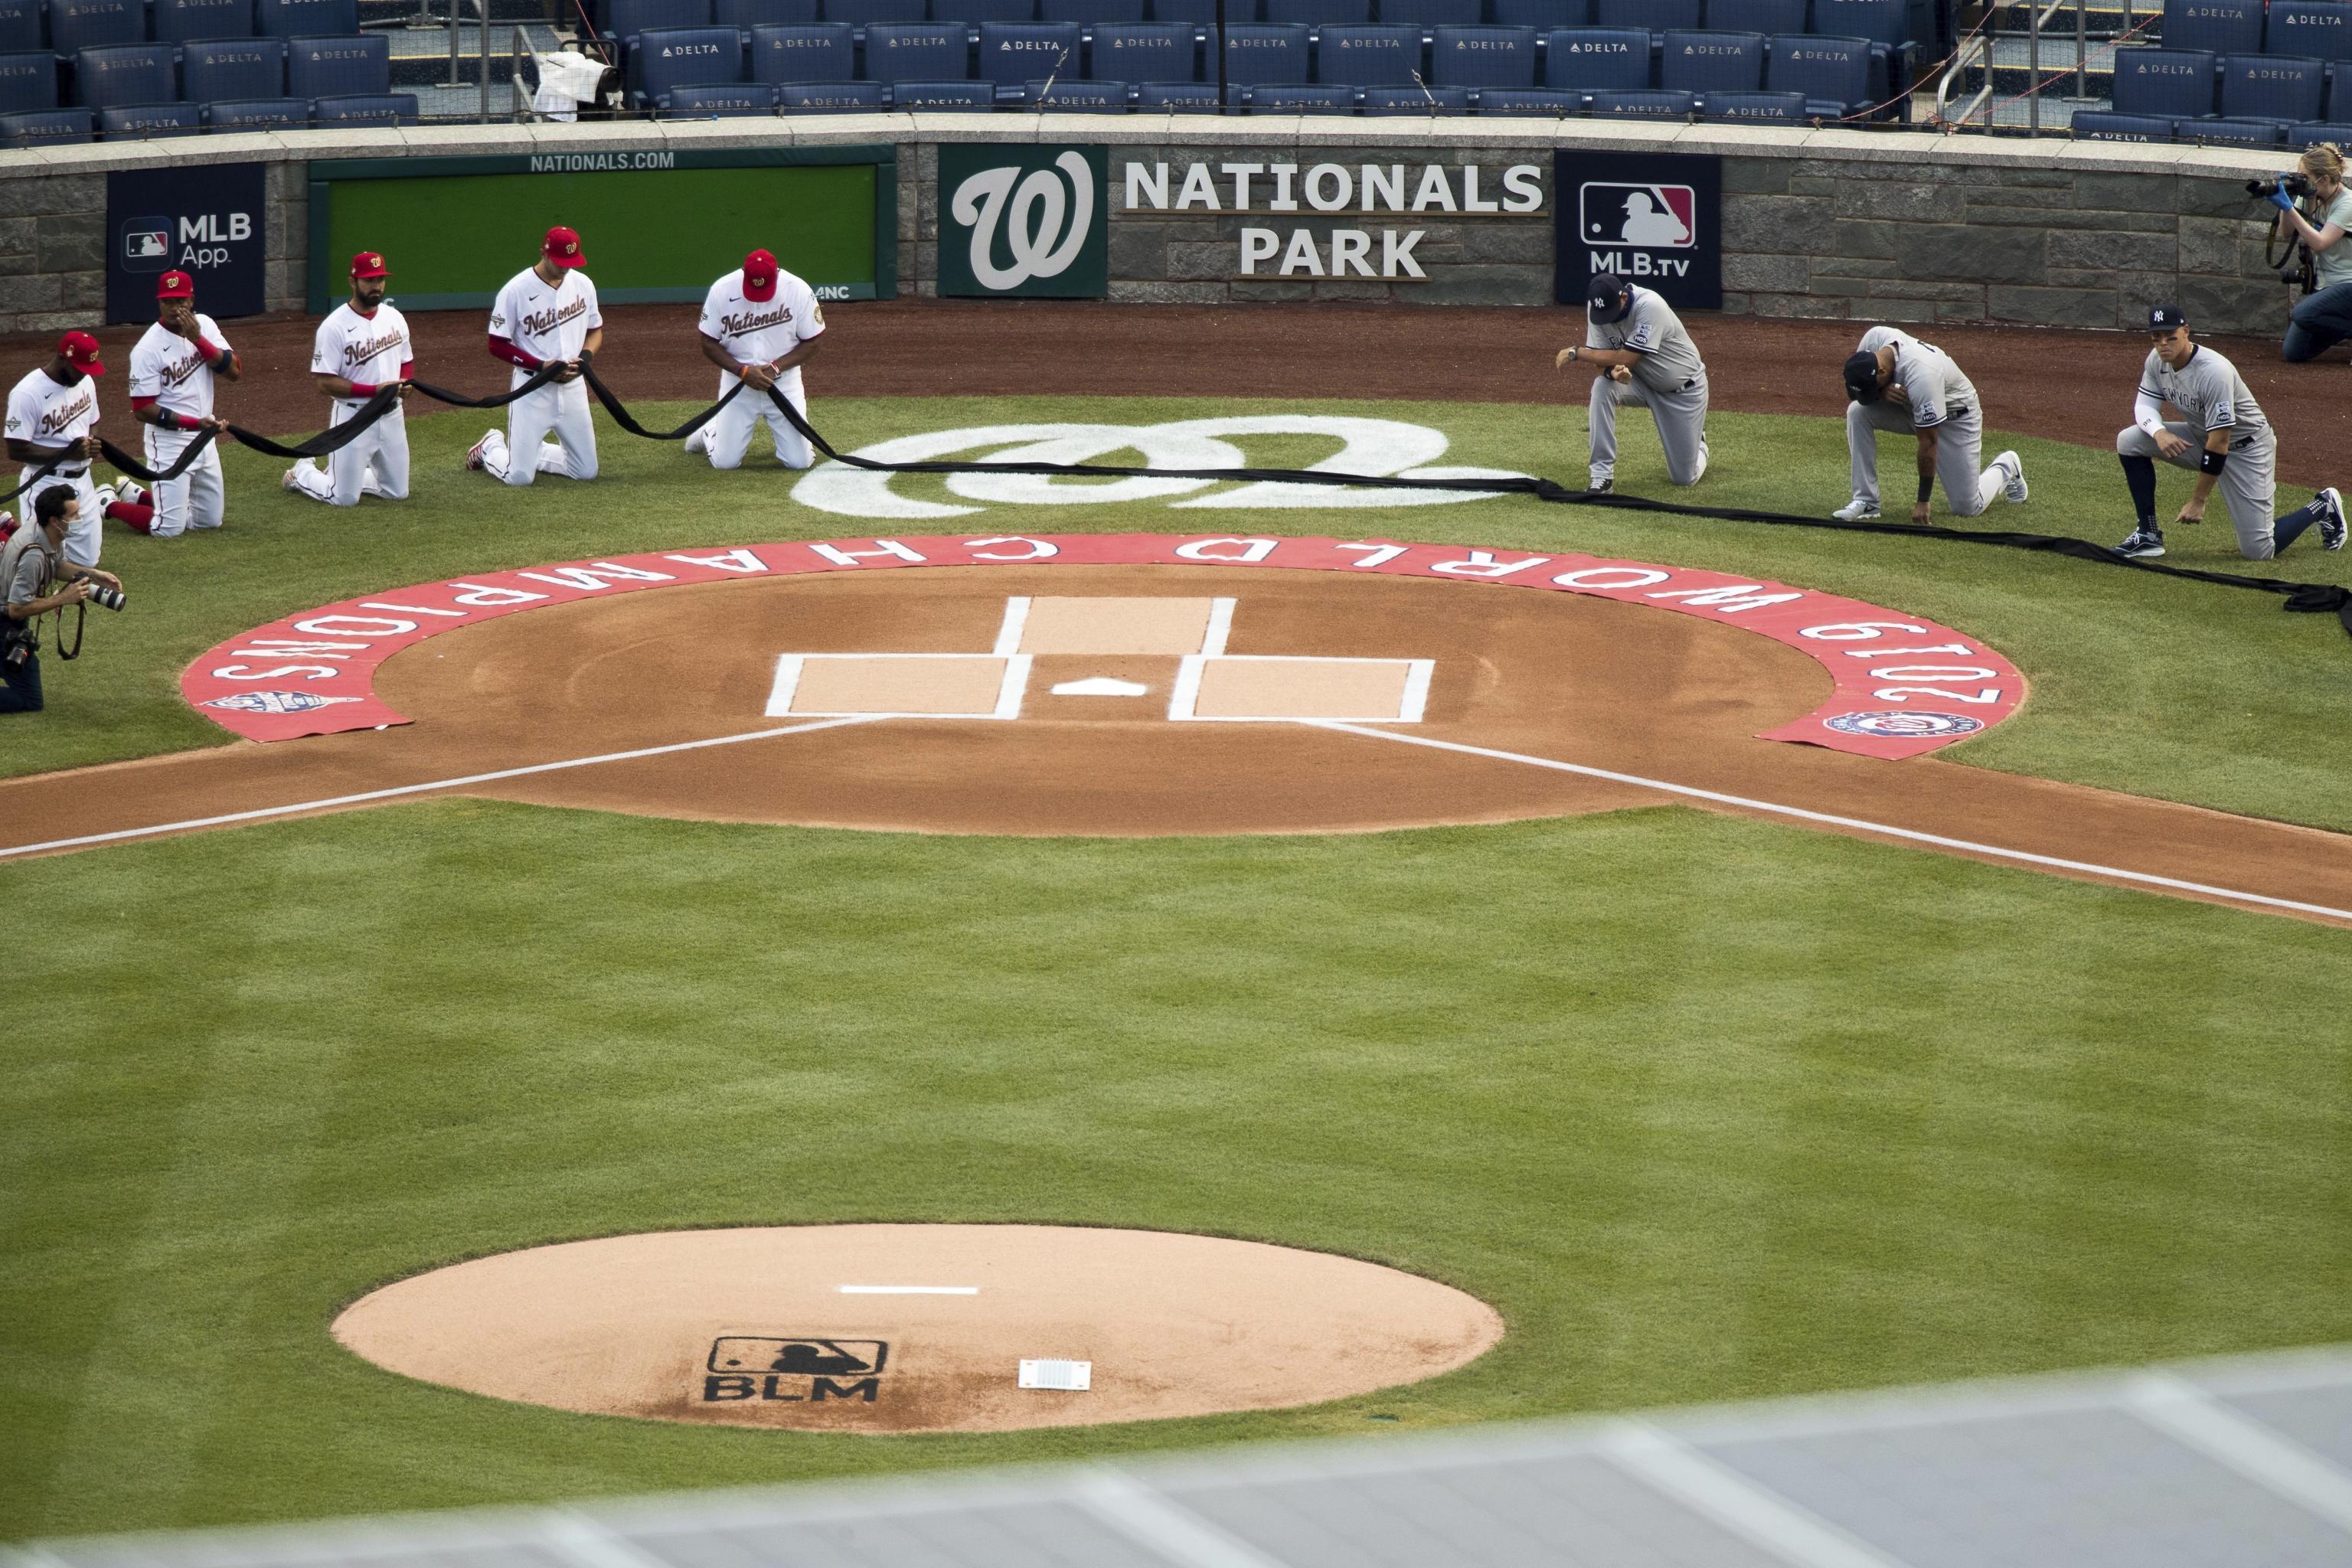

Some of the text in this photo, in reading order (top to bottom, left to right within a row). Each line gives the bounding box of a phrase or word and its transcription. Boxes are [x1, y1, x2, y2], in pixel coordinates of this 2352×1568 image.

[81, 4, 124, 13] DELTA
[2201, 8, 2243, 18] DELTA
[2301, 15, 2341, 25] DELTA
[787, 39, 831, 47] DELTA
[903, 38, 946, 46] DELTA
[1015, 41, 1060, 50] DELTA
[1129, 38, 1172, 47] DELTA
[1243, 39, 1287, 47] DELTA
[1354, 39, 1400, 47] DELTA
[1471, 41, 1514, 50] DELTA
[676, 44, 719, 55] DELTA
[1585, 44, 1628, 53] DELTA
[1698, 46, 1741, 54] DELTA
[219, 54, 262, 63] DELTA
[325, 50, 368, 59] DELTA
[1806, 51, 1848, 60] DELTA
[112, 58, 155, 67] DELTA
[2152, 65, 2194, 75] DELTA
[2261, 70, 2303, 80] DELTA
[1062, 96, 1106, 105] DELTA
[1741, 108, 1783, 116] DELTA
[531, 152, 675, 172] NATIONALS.COM
[1125, 162, 1543, 212] NATIONALS
[952, 151, 1094, 290] W
[179, 213, 251, 243] MLB
[1241, 227, 1426, 277] PARK
[1591, 251, 1690, 277] MLB.TV
[524, 294, 586, 336] Nationals
[721, 302, 792, 337] Nationals
[345, 325, 403, 367] Nationals
[2175, 391, 2206, 413] YORK
[41, 390, 91, 435] Nationals
[211, 536, 2004, 704] 2019 WORLD CHAMPIONS
[704, 1375, 880, 1403] BLM
